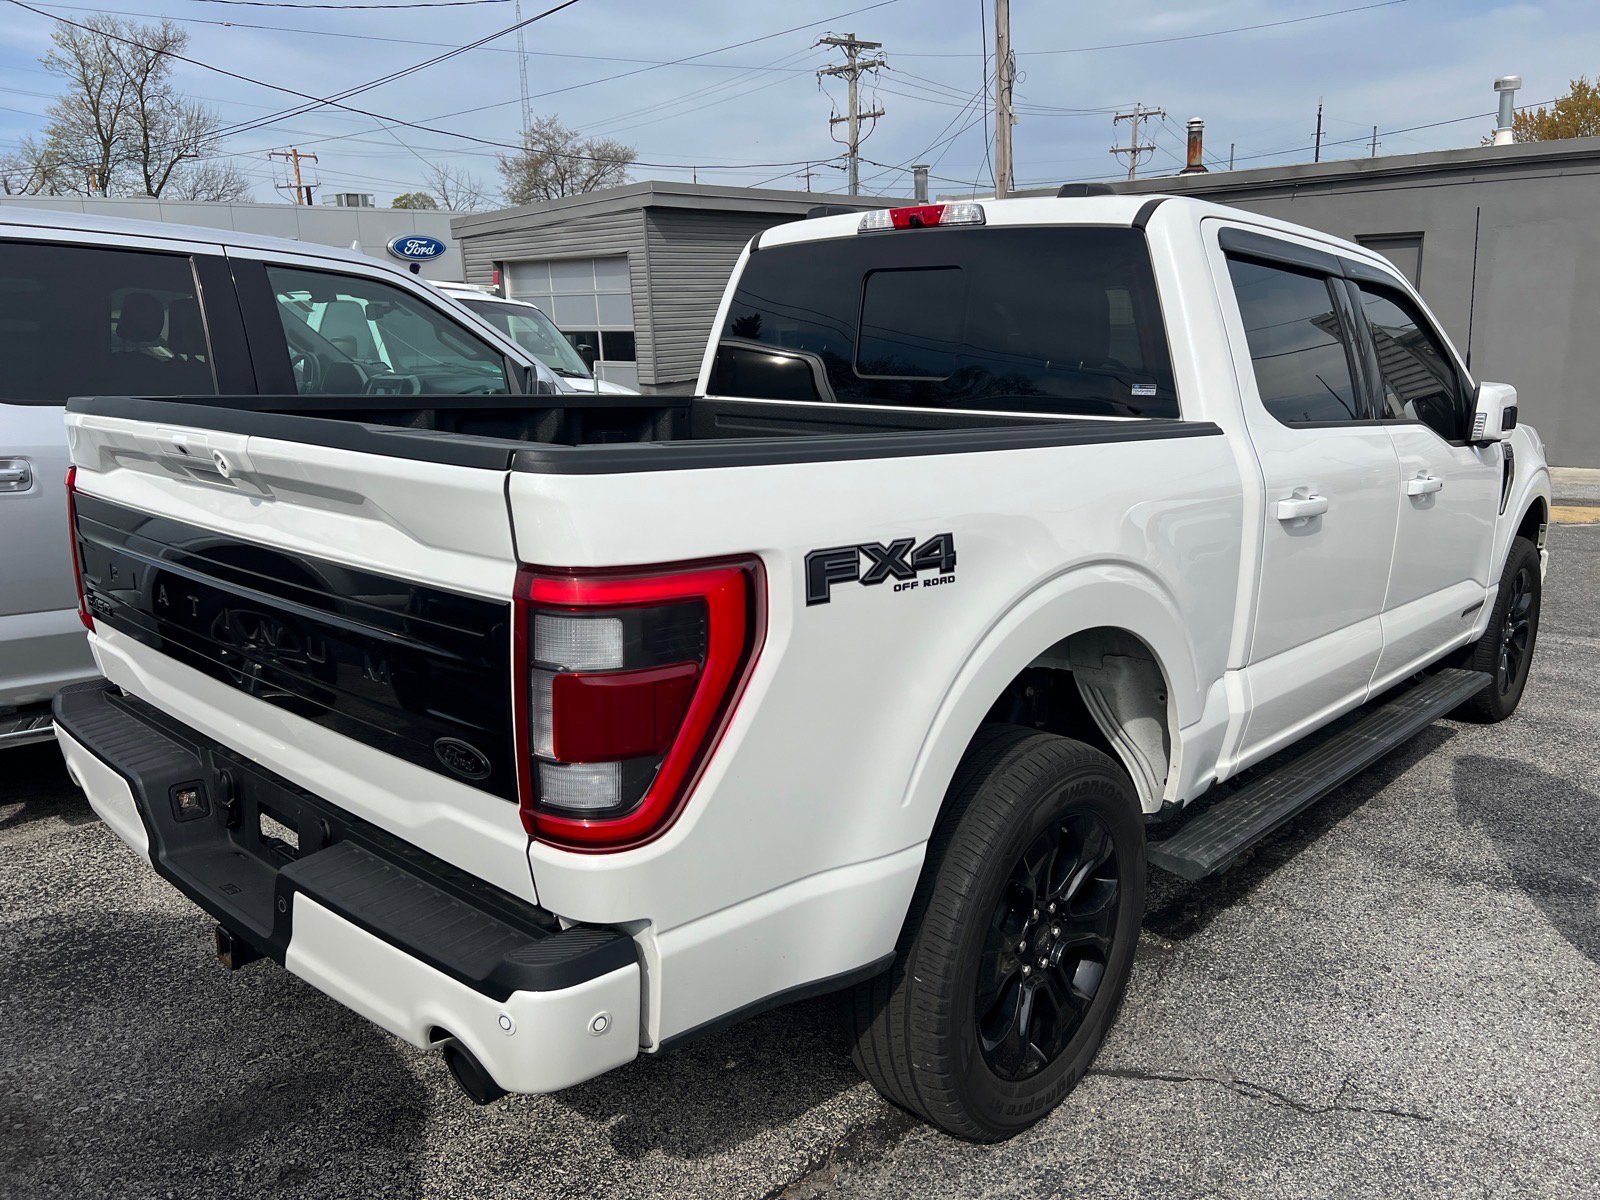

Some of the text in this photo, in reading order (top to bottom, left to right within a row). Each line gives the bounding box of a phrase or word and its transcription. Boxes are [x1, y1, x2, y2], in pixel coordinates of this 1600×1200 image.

[404, 239, 436, 255] Ford
[804, 532, 957, 608] FX4
[894, 574, 956, 593] OFF ROAD
